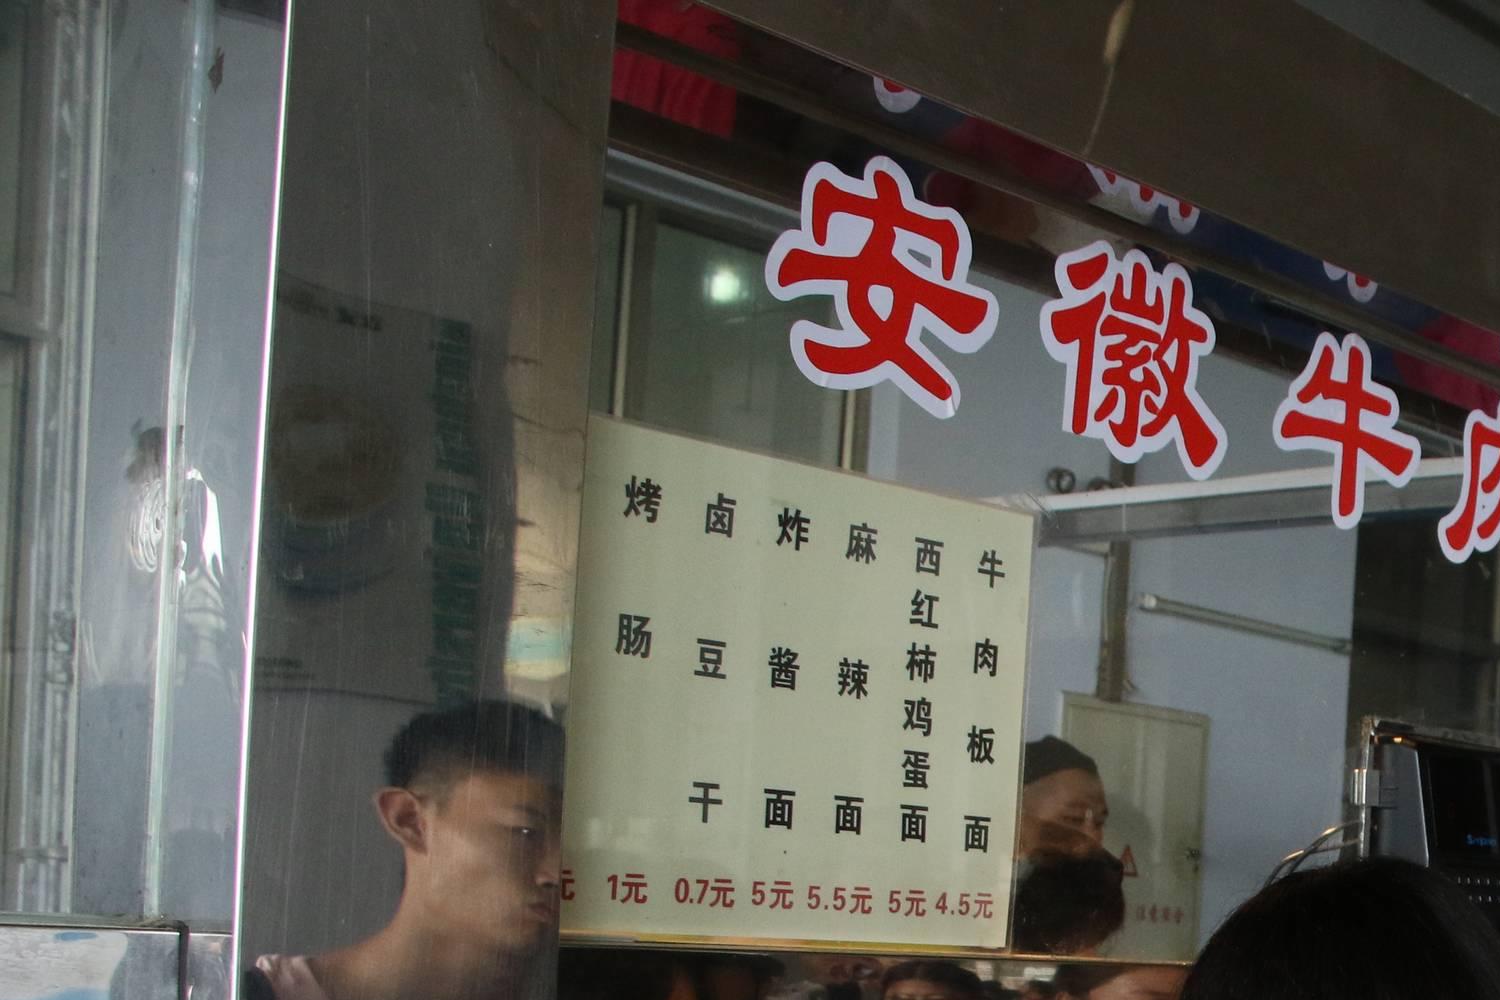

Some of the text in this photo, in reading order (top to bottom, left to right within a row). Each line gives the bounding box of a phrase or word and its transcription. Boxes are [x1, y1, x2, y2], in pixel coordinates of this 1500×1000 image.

[616, 475, 662, 659] 烤肠
[689, 493, 737, 823] 卤豆干
[764, 507, 810, 830] 炸酱面
[834, 522, 878, 835] 麻辣面
[900, 536, 944, 843] 西红柿鸡蛋面
[964, 550, 1006, 853] 牛肉板面
[607, 873, 648, 904] 1元
[674, 877, 735, 908] 0.7元
[751, 880, 794, 909] 5元
[807, 885, 873, 914] 5.5元
[888, 890, 926, 917] 5元
[935, 892, 993, 919] 4.5元
